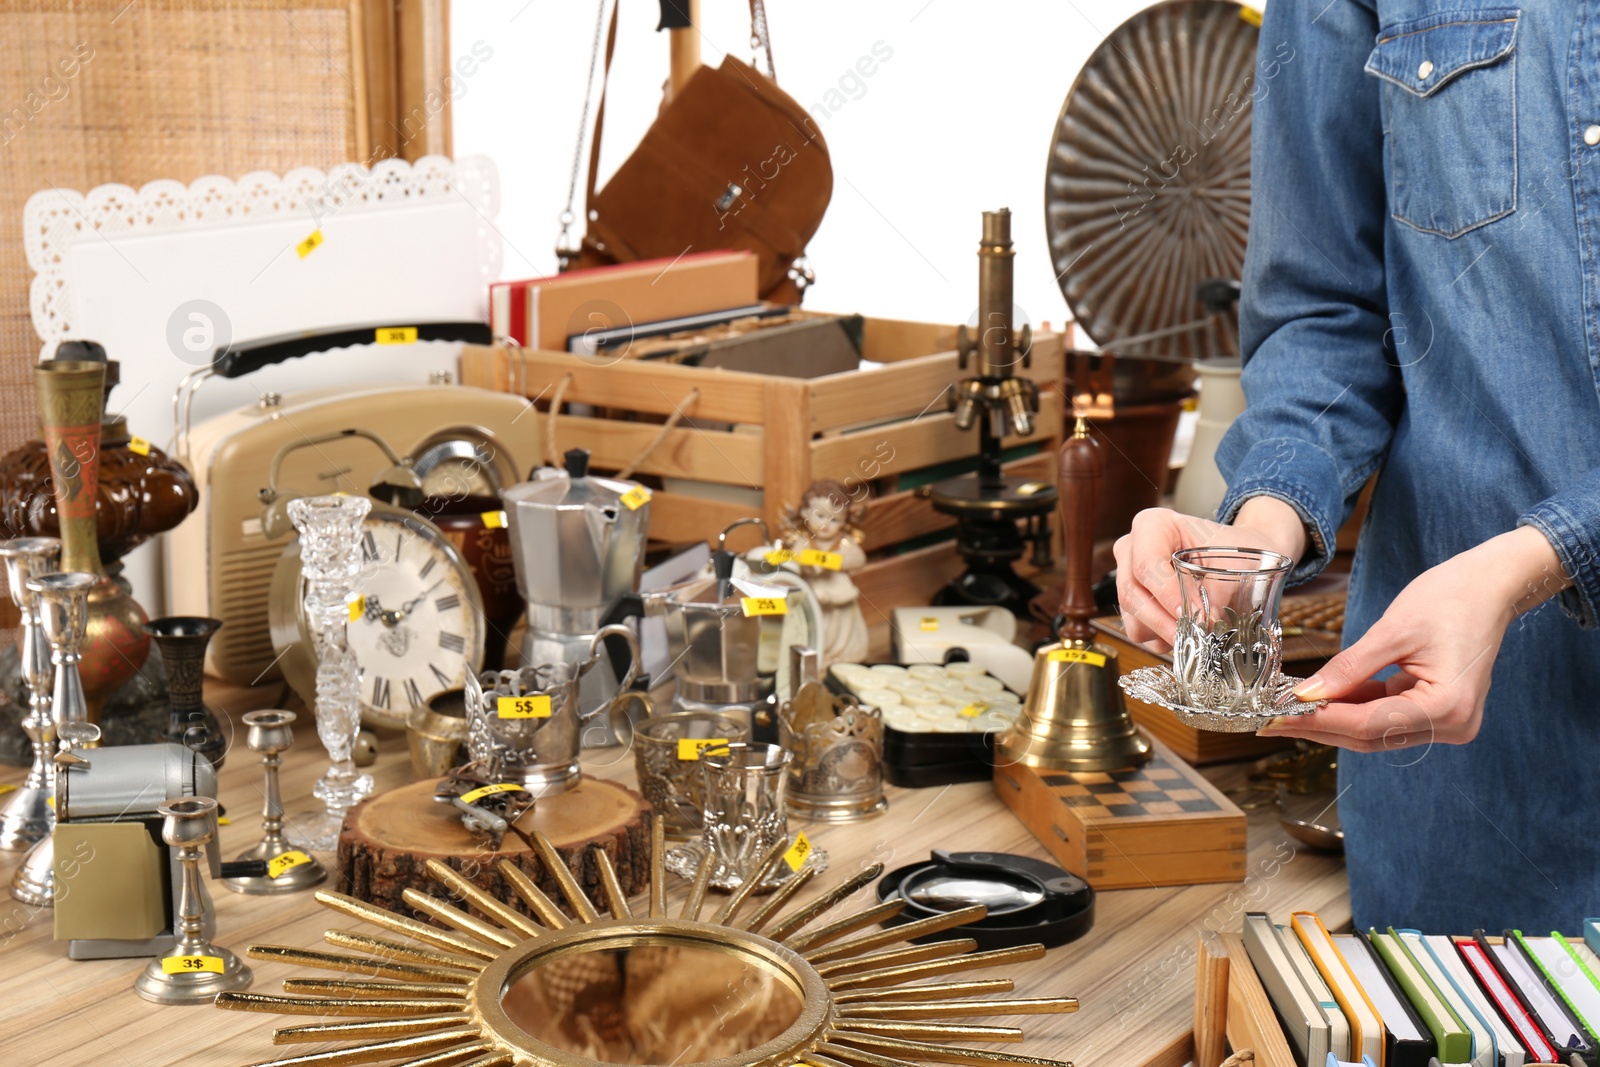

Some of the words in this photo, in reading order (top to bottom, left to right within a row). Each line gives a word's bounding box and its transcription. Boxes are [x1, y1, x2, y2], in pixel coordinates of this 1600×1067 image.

[1066, 652, 1087, 660] 15$
[515, 700, 534, 715] 5$
[275, 855, 295, 868] 3$
[182, 958, 204, 970] 3$
